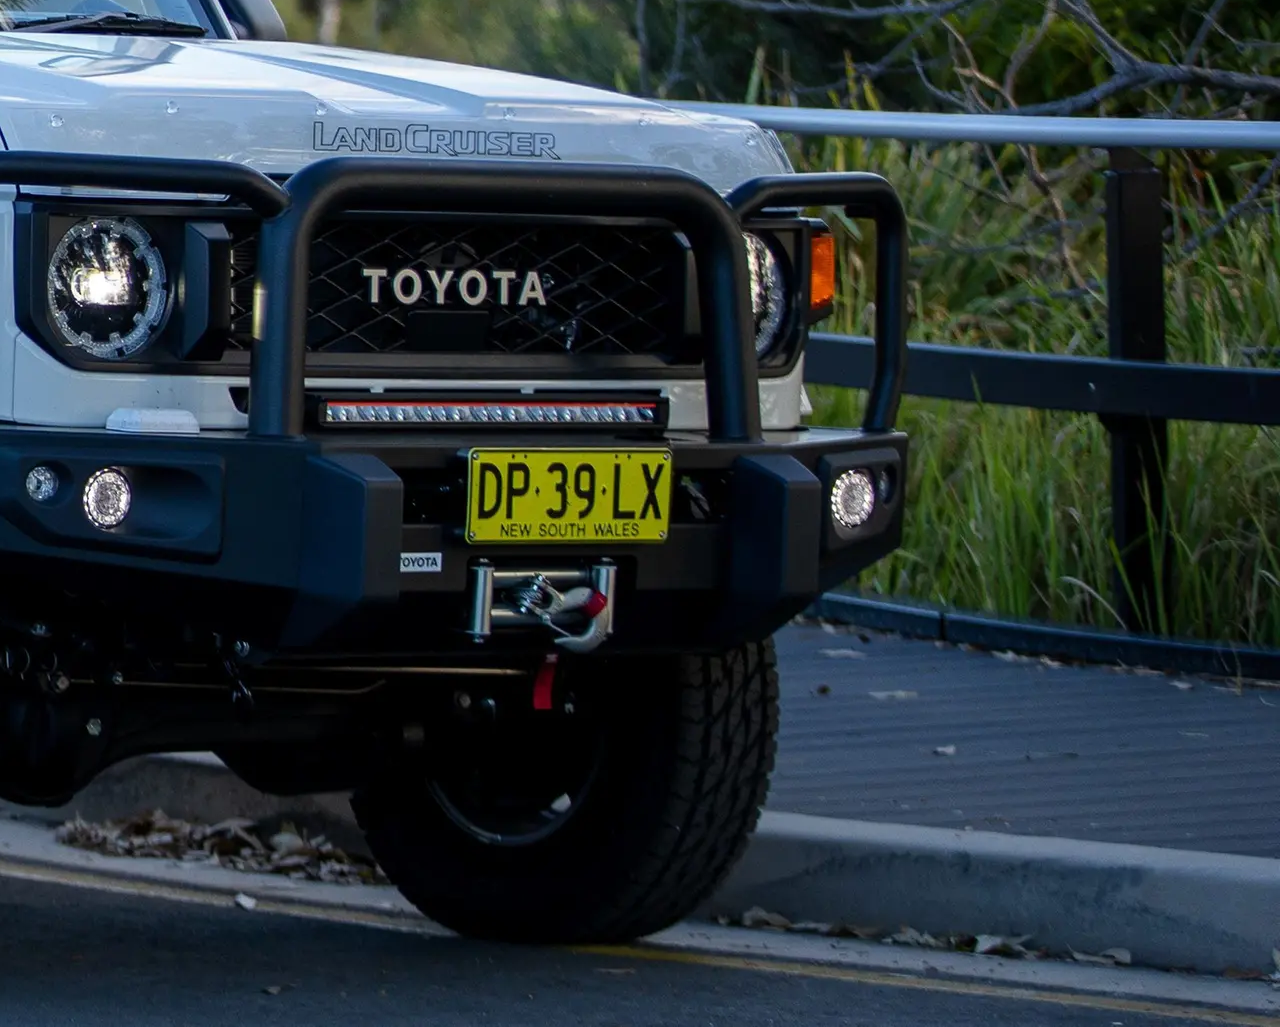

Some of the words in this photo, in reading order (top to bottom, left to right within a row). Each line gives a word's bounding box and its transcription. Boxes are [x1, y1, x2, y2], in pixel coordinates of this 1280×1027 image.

[363, 268, 547, 306] TOYOTA
[500, 522, 531, 537] NEW
[538, 523, 586, 538] SOUTH
[593, 523, 640, 538] WALES
[400, 557, 438, 568] OYOTA
